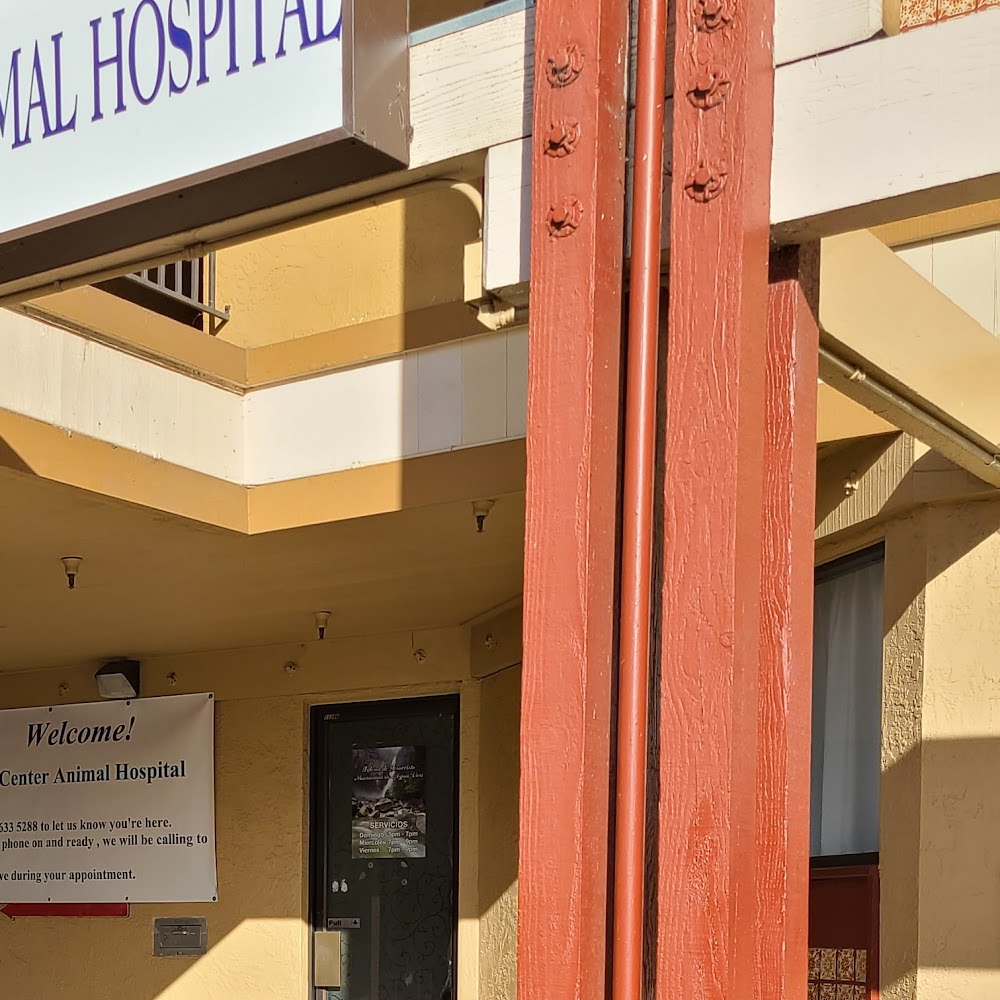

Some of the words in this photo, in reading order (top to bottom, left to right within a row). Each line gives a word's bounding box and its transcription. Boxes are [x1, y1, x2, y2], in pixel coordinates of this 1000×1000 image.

[27, 716, 136, 748] Welcome!
[0, 770, 49, 787] Center
[53, 764, 110, 784] Animal
[115, 760, 186, 784] Hospital
[16, 820, 38, 832] 5288
[40, 821, 50, 831] to
[52, 820, 64, 831] let
[66, 821, 77, 831] us
[80, 819, 107, 831] know
[109, 818, 142, 832] you're
[145, 817, 172, 828] here.
[369, 820, 408, 829] SERVICIOS
[2, 838, 29, 851] phone
[32, 840, 43, 848] on
[45, 836, 63, 848] and
[66, 836, 94, 849] ready
[103, 837, 117, 846] we
[119, 834, 138, 846] will
[141, 834, 154, 845] be
[156, 833, 194, 847] calling
[196, 833, 208, 844] to
[11, 869, 41, 883] during
[43, 872, 67, 883] your
[69, 868, 136, 883] appointment.
